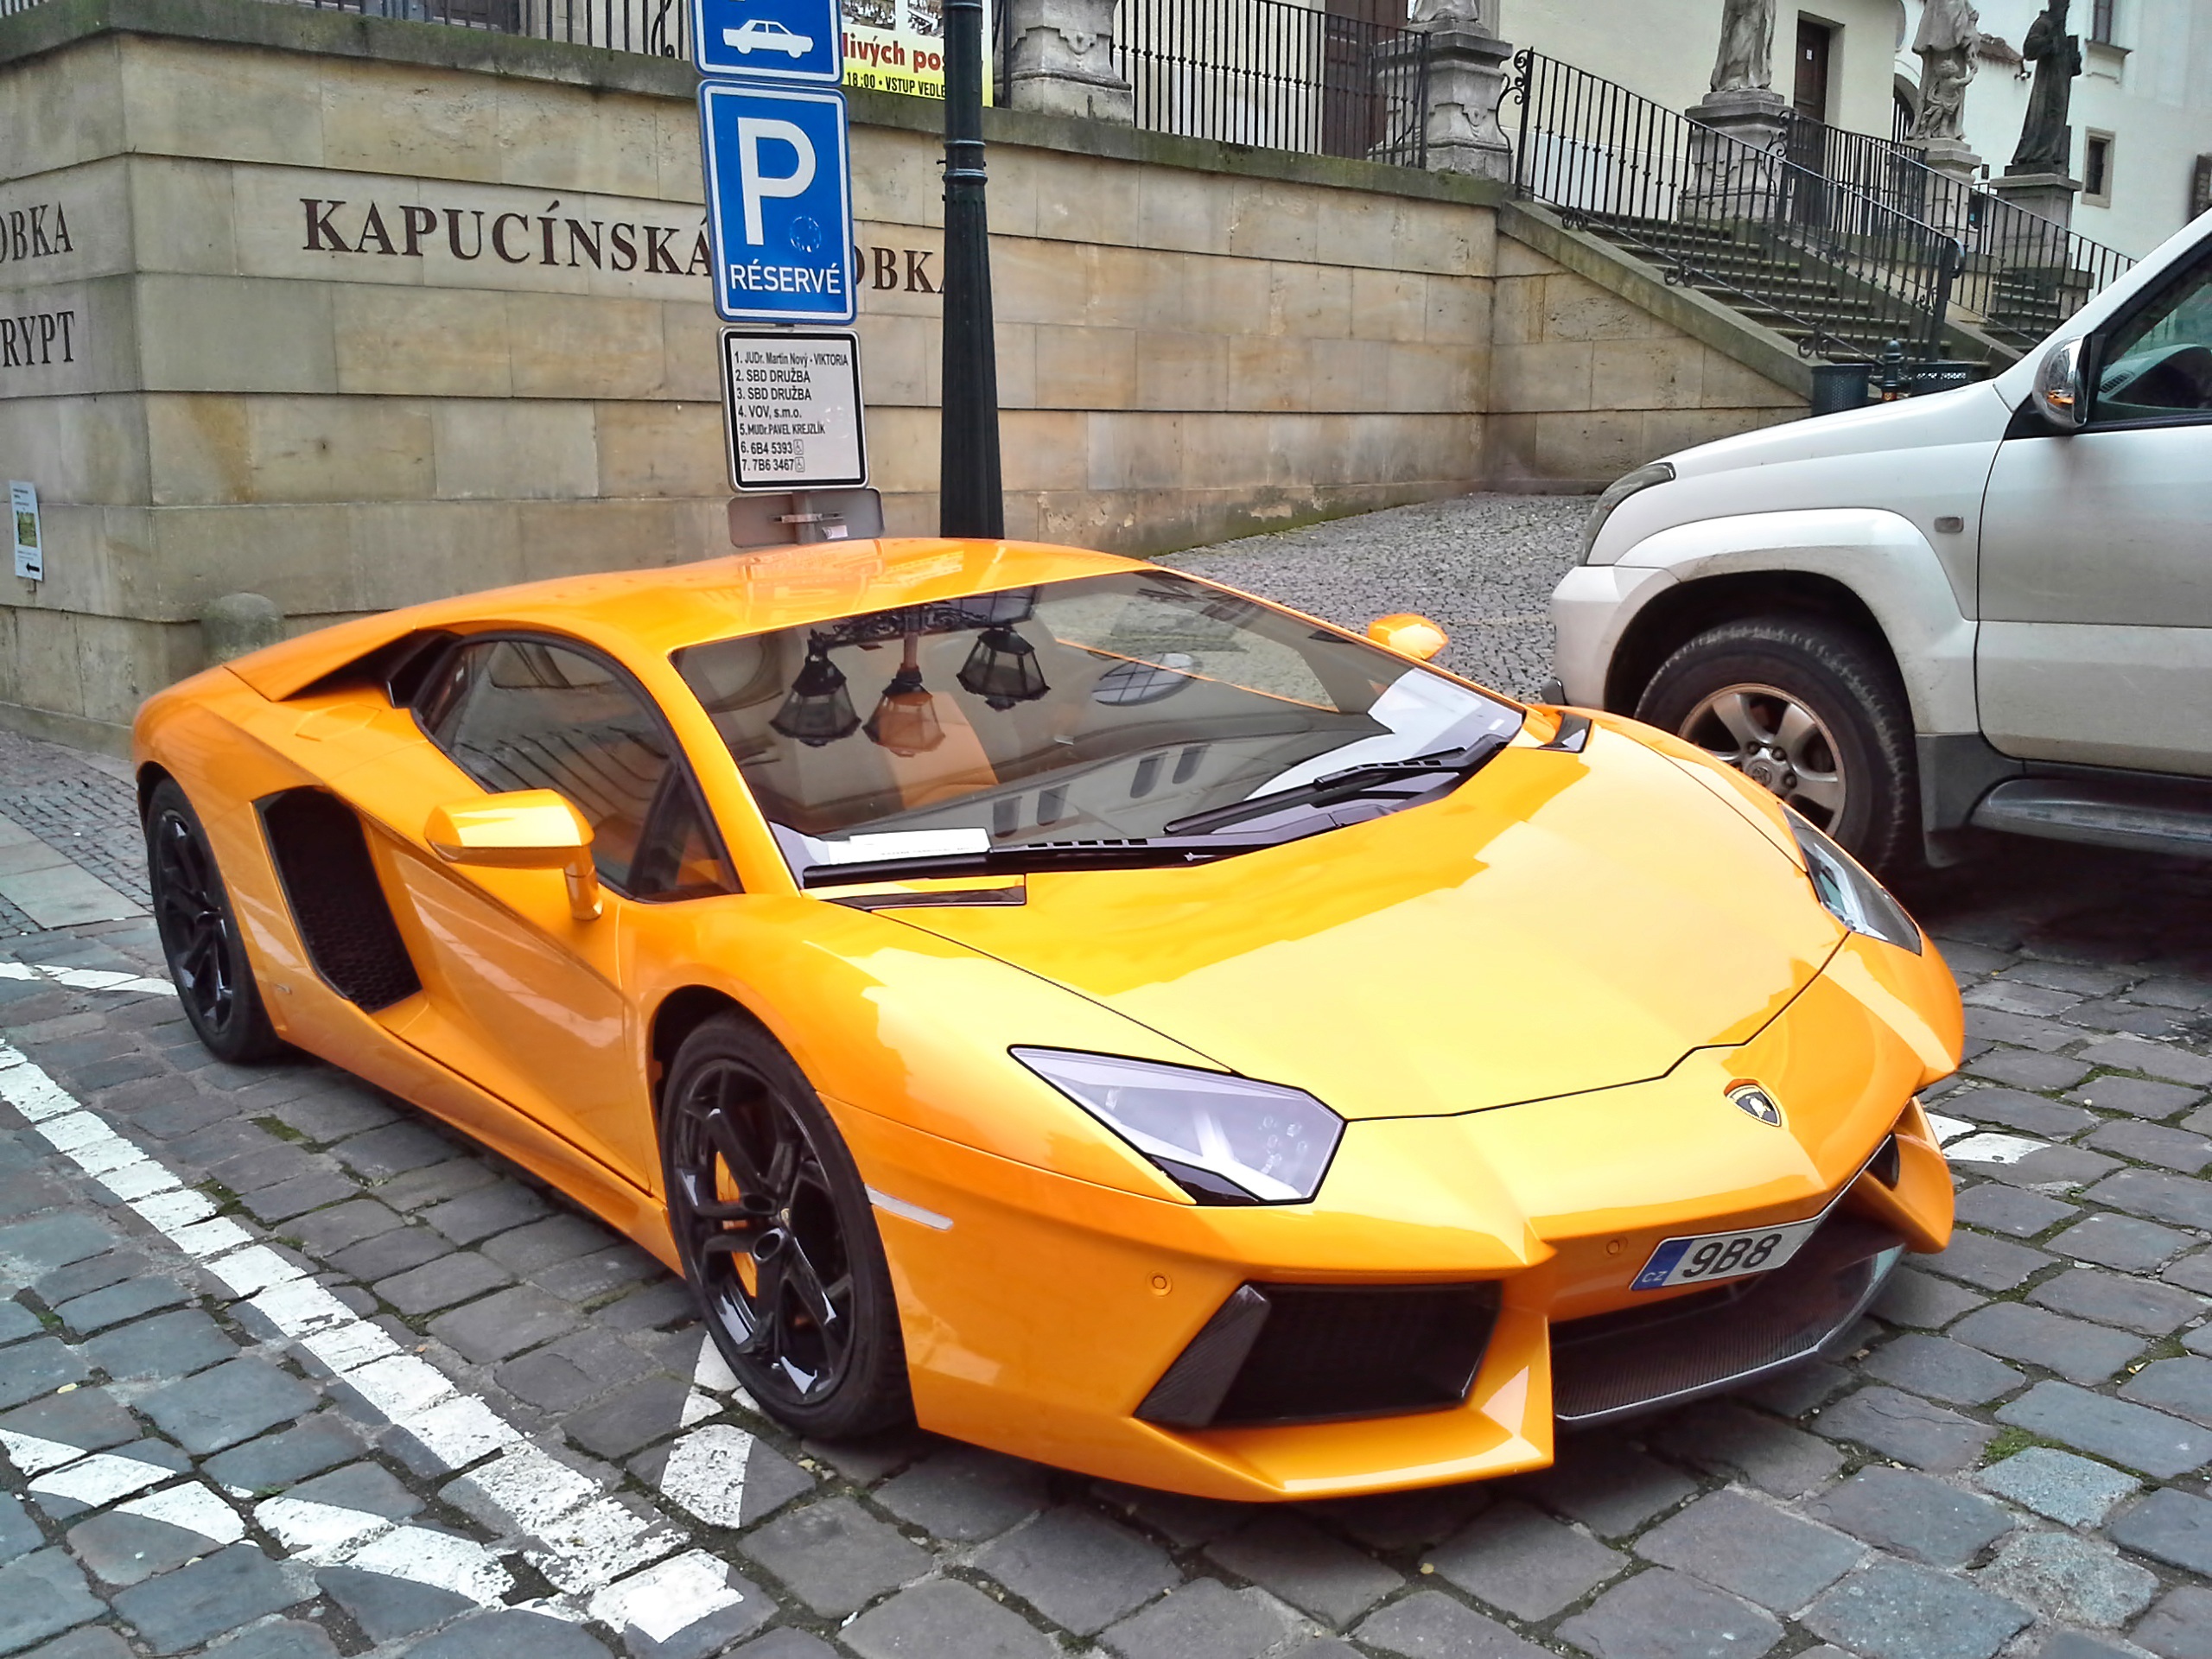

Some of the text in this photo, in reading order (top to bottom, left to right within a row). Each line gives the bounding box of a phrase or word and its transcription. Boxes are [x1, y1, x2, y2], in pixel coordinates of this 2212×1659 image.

[886, 76, 915, 92] VSTUP
[737, 117, 817, 245] P
[299, 198, 944, 294] KAPUCÍNSKÁ BK
[730, 258, 841, 294] RÉSERVÉ
[734, 351, 743, 364] 1.
[766, 353, 789, 365] Martin
[790, 353, 808, 368] Nový
[813, 353, 849, 366] VIKTORIA
[735, 367, 811, 383] 2. SBD DRUŽBA
[737, 385, 811, 401] 3. SBD DRUŽBA
[738, 405, 802, 420] 4. VOV, s.m.o.
[741, 441, 793, 454] 6. 6B4 5393
[741, 459, 794, 471] 7. 7B6 3467
[1642, 1233, 1783, 1284] CZ 9B8
